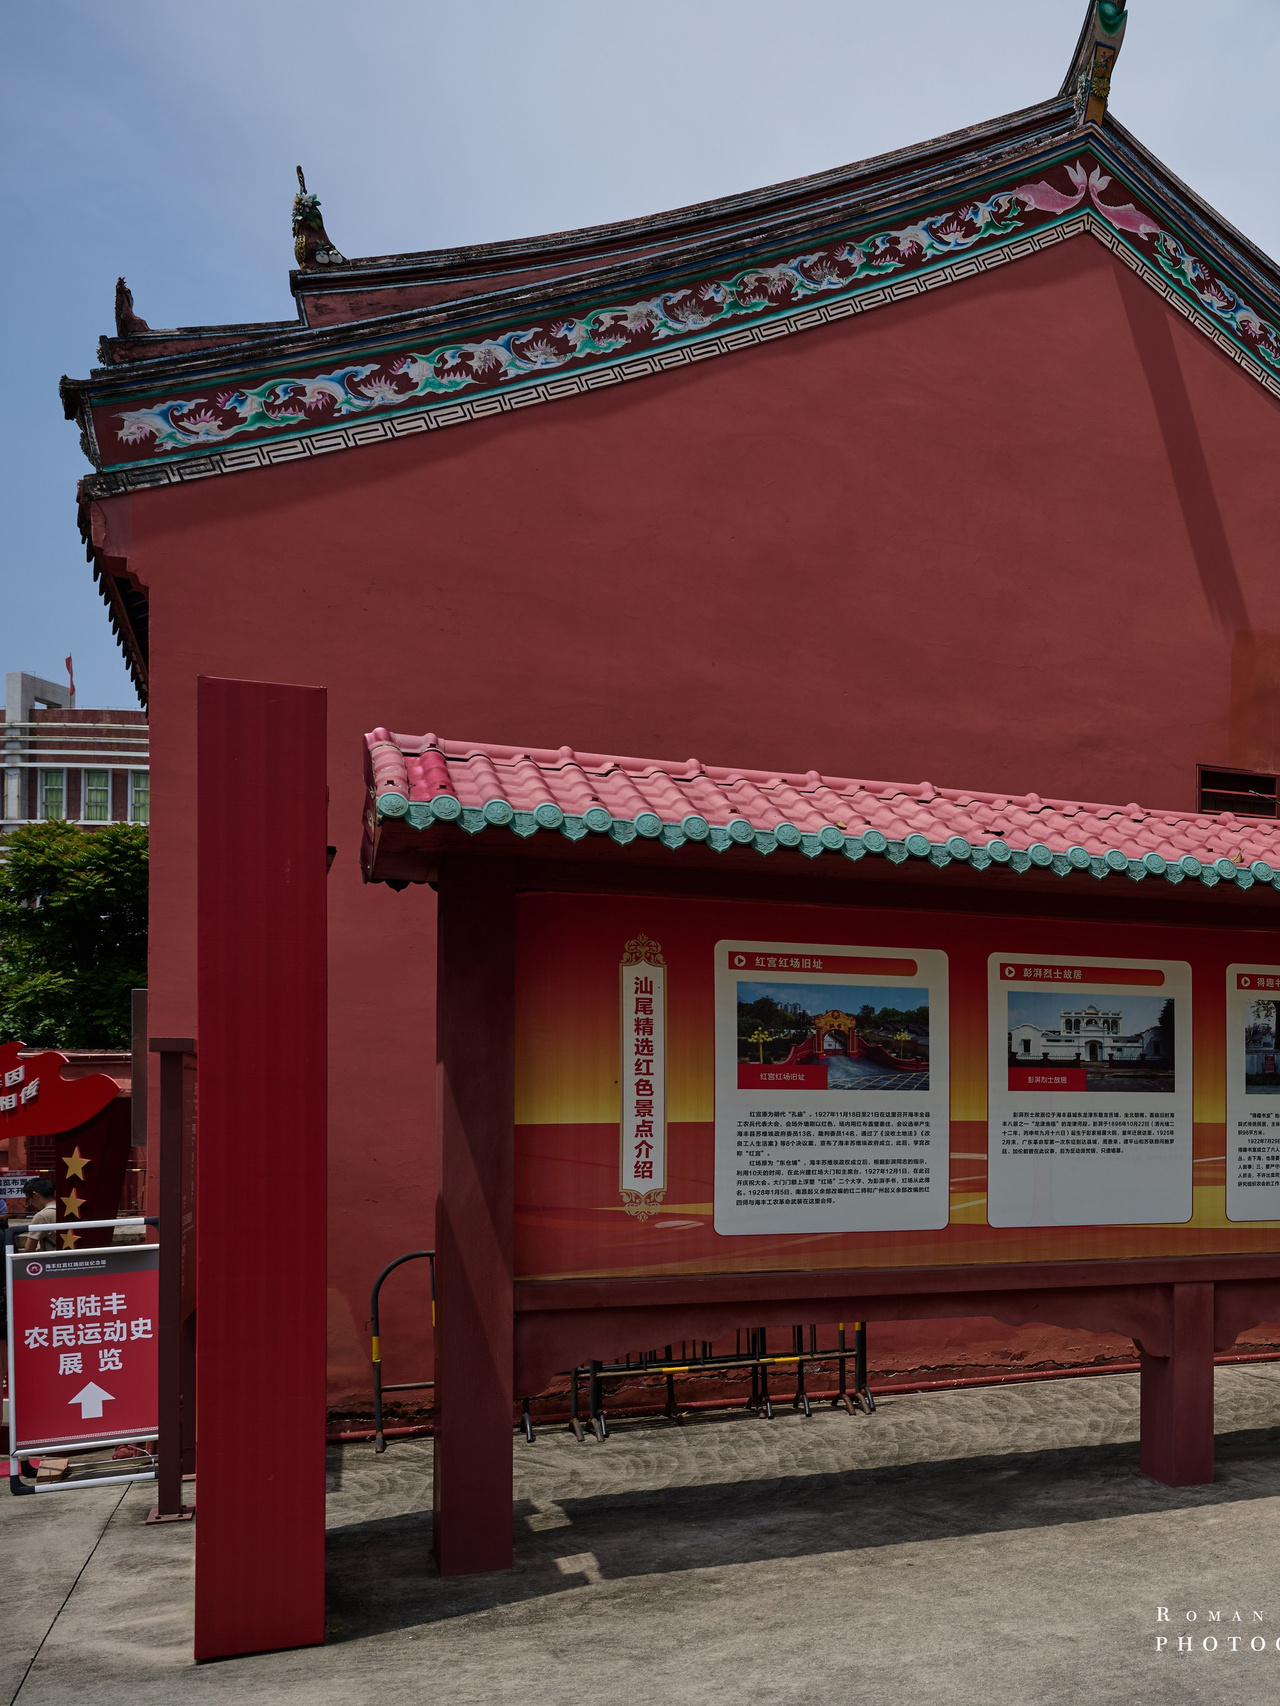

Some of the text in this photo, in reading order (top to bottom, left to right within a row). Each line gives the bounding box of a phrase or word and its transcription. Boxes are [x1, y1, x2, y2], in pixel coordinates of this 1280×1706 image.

[755, 956, 823, 969] 红宫红场旧址
[1022, 967, 1082, 980] 彭湃烈士故居
[634, 976, 654, 1179] 汕尾精选红色景点介绍
[760, 1072, 805, 1081] 红宫红场旧址
[50, 1292, 127, 1320] 海陆丰
[24, 1317, 154, 1349] 农民运动史
